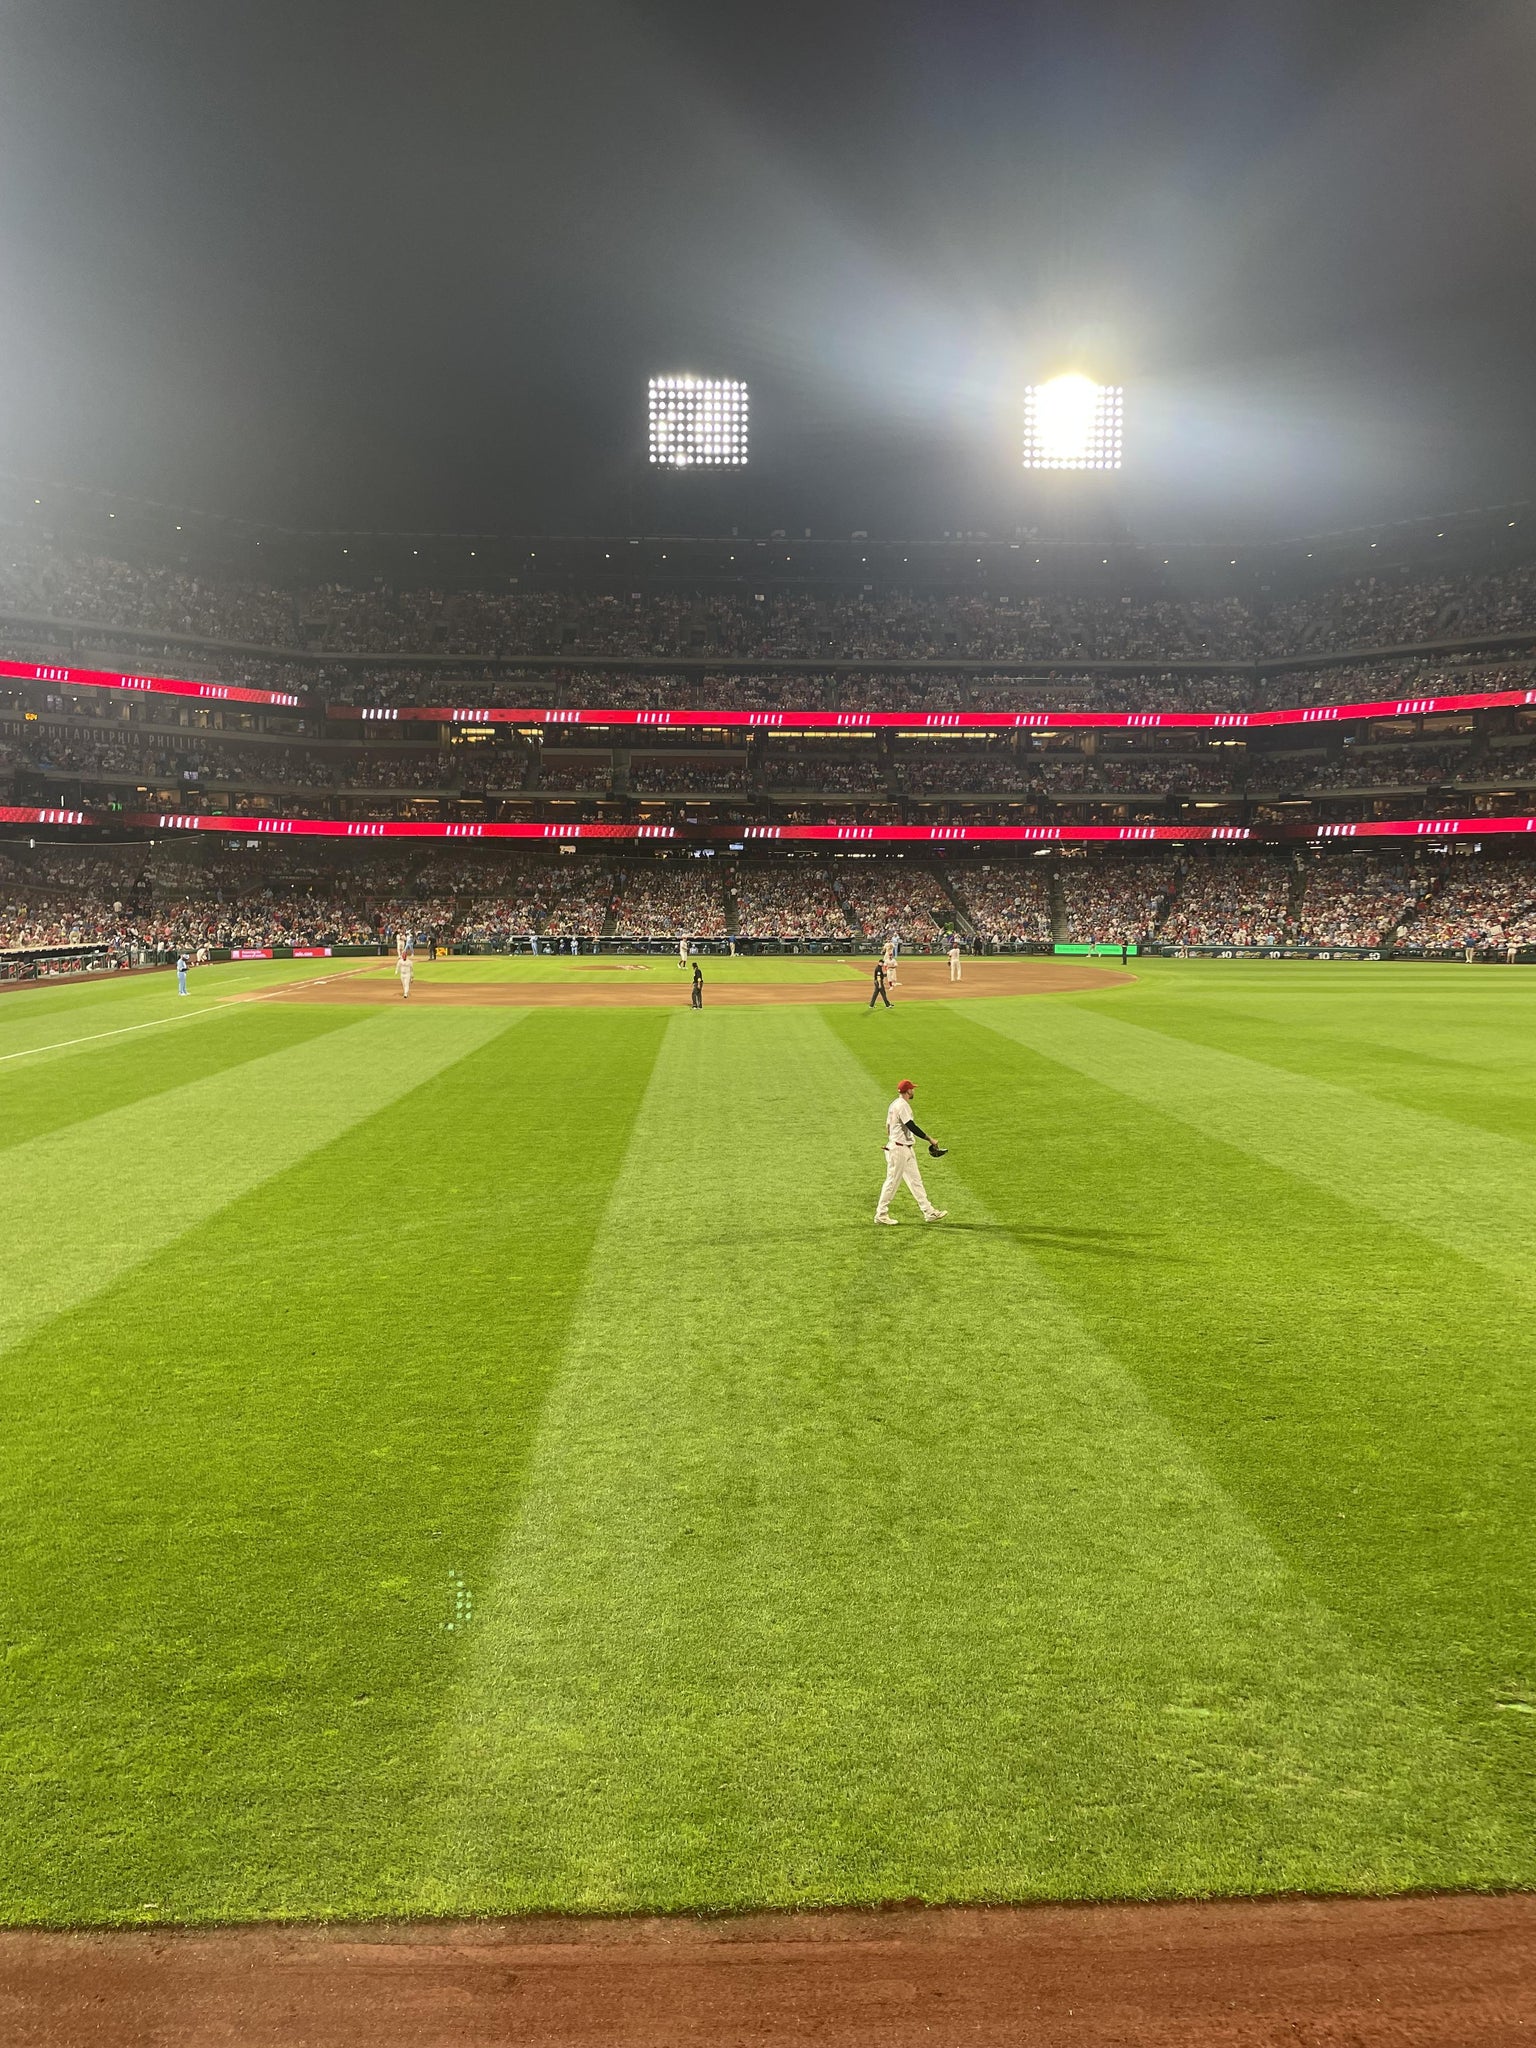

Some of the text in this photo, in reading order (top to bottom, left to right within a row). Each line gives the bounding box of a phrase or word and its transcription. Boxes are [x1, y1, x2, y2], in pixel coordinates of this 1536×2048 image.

[3, 722, 207, 750] THE PHILADELPHIA PHILLIES
[1221, 951, 1232, 959] 10
[1269, 951, 1280, 959] 10
[1318, 952, 1330, 960] 10
